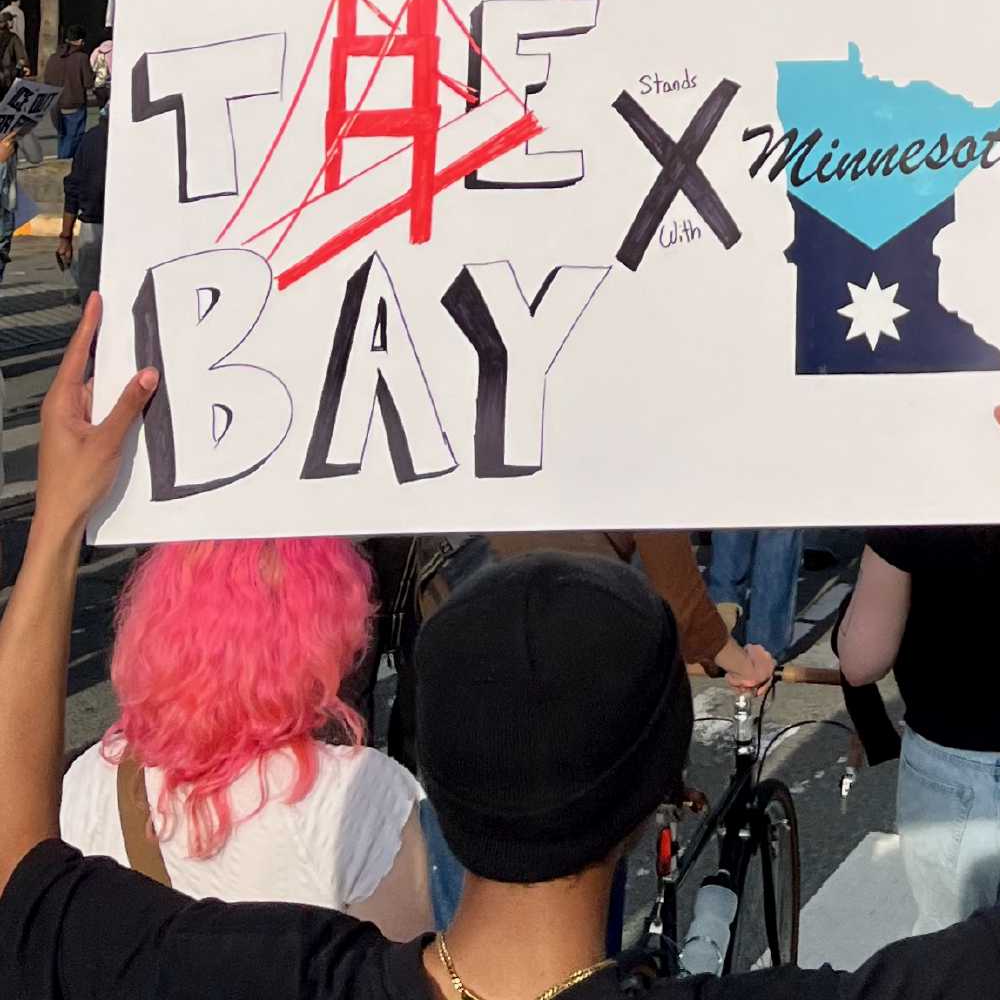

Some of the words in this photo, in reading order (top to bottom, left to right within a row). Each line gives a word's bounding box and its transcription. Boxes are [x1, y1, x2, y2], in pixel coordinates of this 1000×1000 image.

[639, 68, 698, 96] Stands
[658, 219, 703, 250] With
[132, 249, 613, 502] BAY
